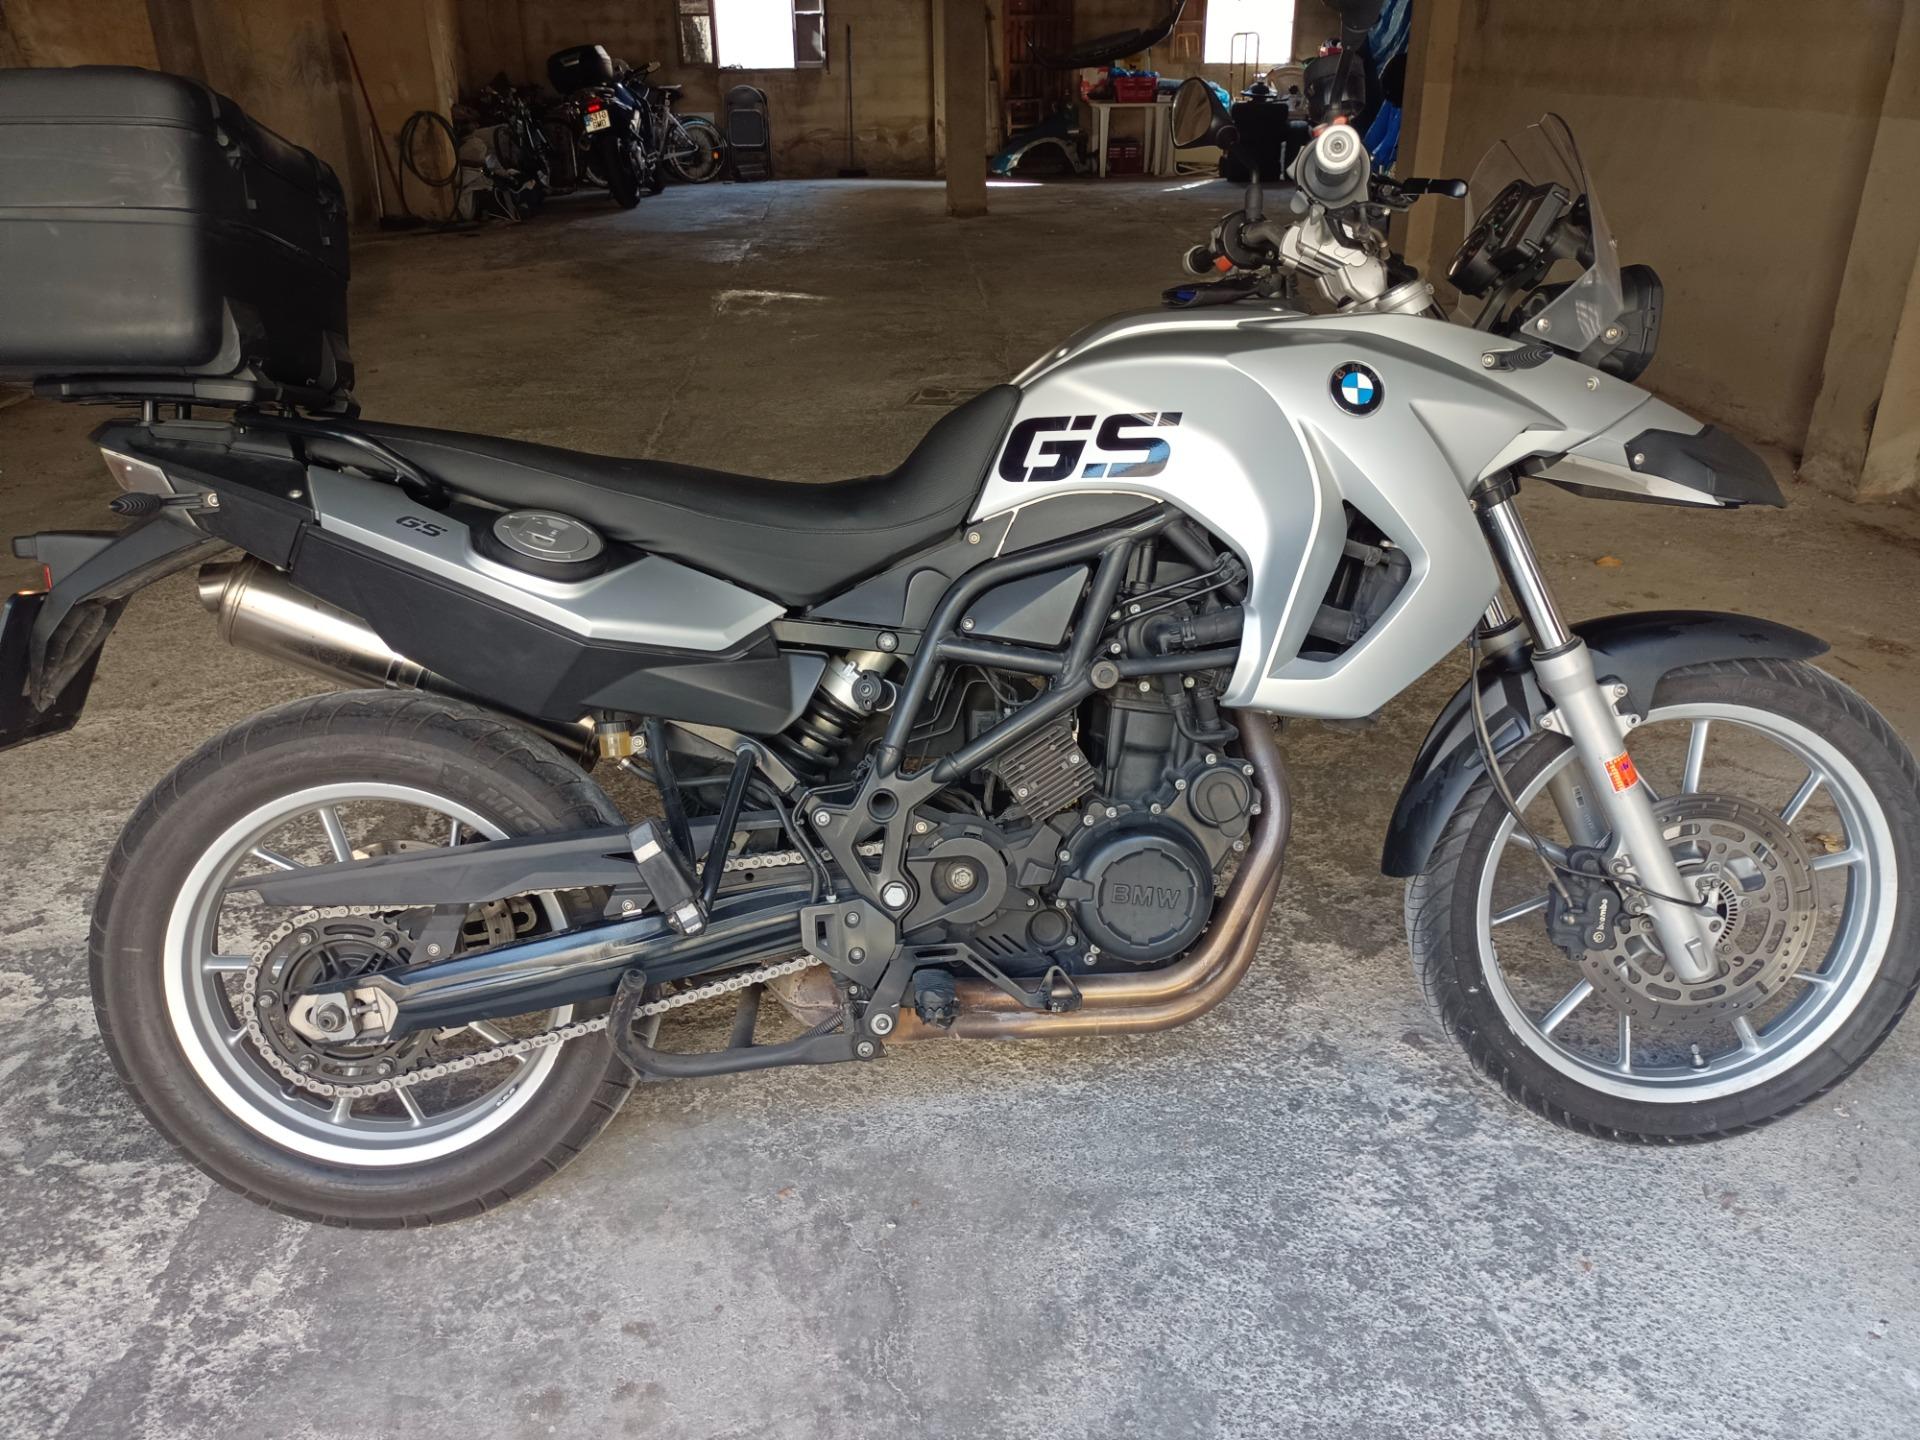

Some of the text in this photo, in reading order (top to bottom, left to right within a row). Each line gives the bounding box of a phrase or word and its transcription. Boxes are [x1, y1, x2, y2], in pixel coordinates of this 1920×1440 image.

[1335, 363, 1378, 382] BMW
[998, 411, 1184, 483] GS
[395, 515, 448, 537] GS
[1111, 883, 1181, 910] BMW
[1596, 898, 1608, 930] brembo
